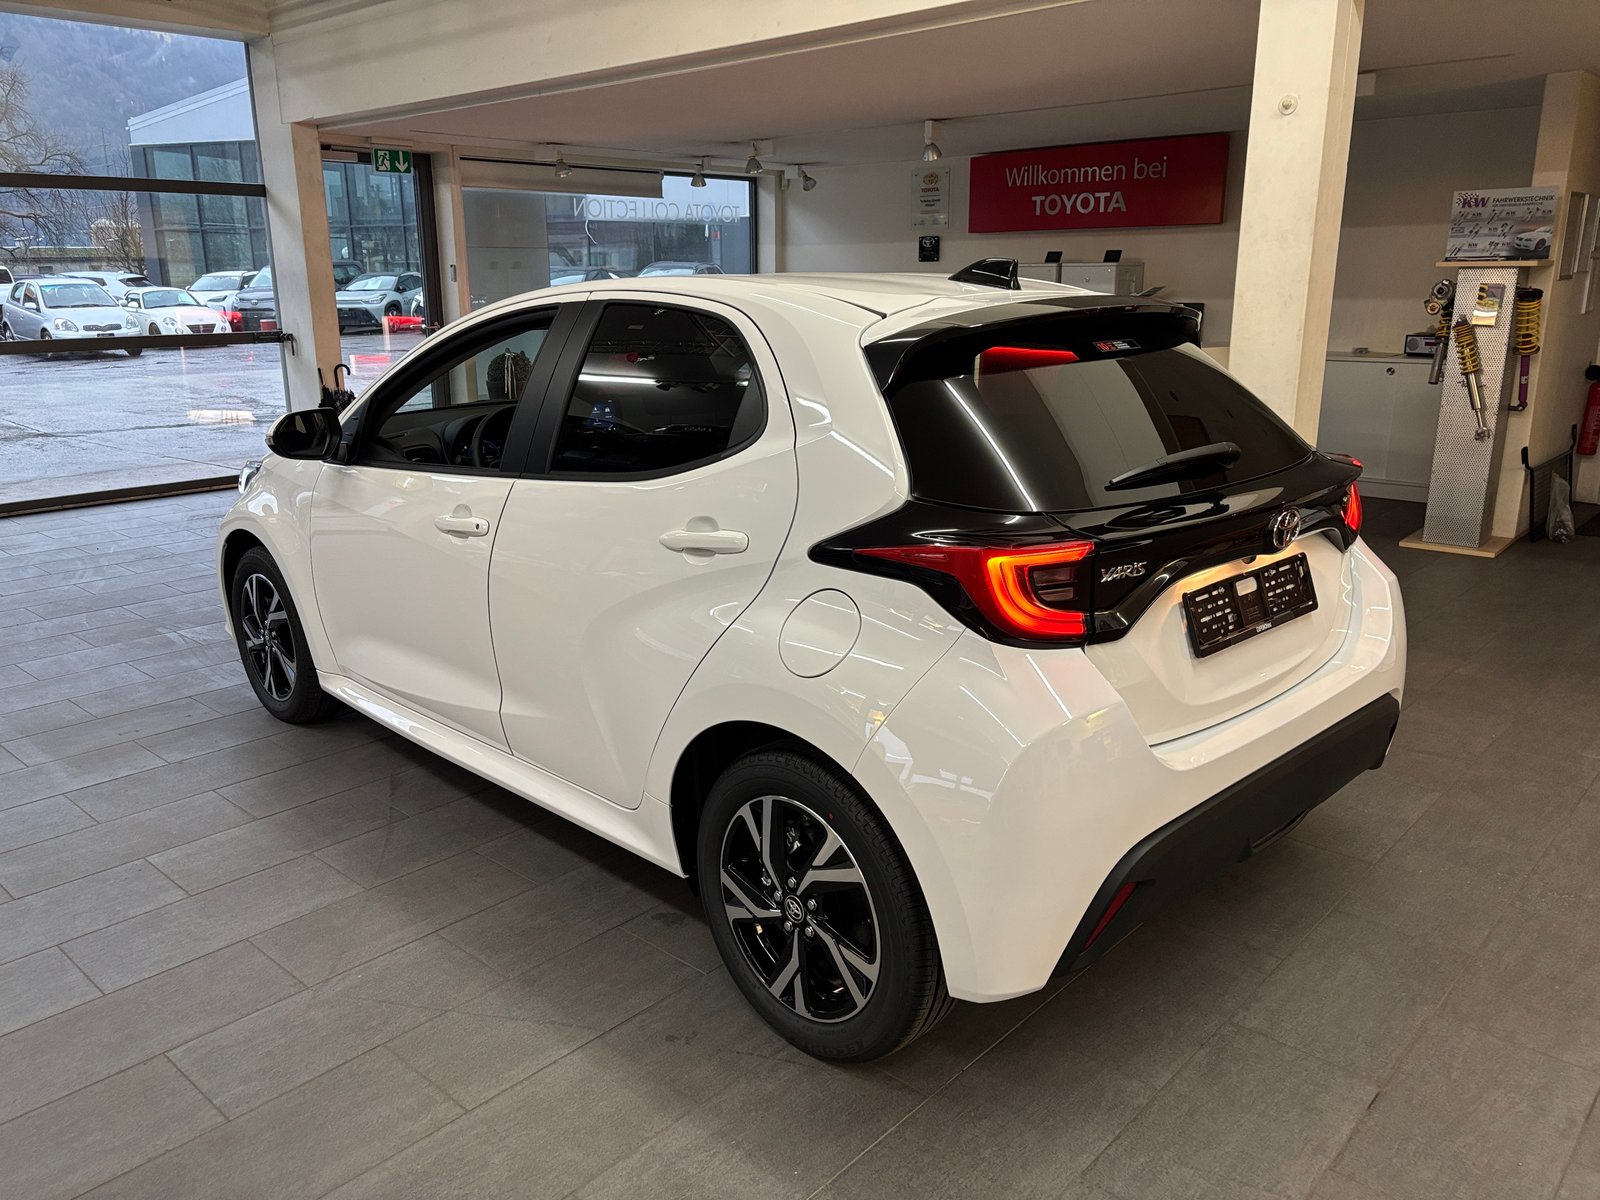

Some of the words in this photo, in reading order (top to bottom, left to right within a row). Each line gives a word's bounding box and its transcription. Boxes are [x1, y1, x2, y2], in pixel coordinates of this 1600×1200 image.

[1006, 164, 1126, 187] Willkommen
[1133, 156, 1168, 180] bei
[1032, 191, 1127, 216] TOYOTA
[1461, 196, 1490, 208] KW
[1100, 561, 1147, 583] YARIS
